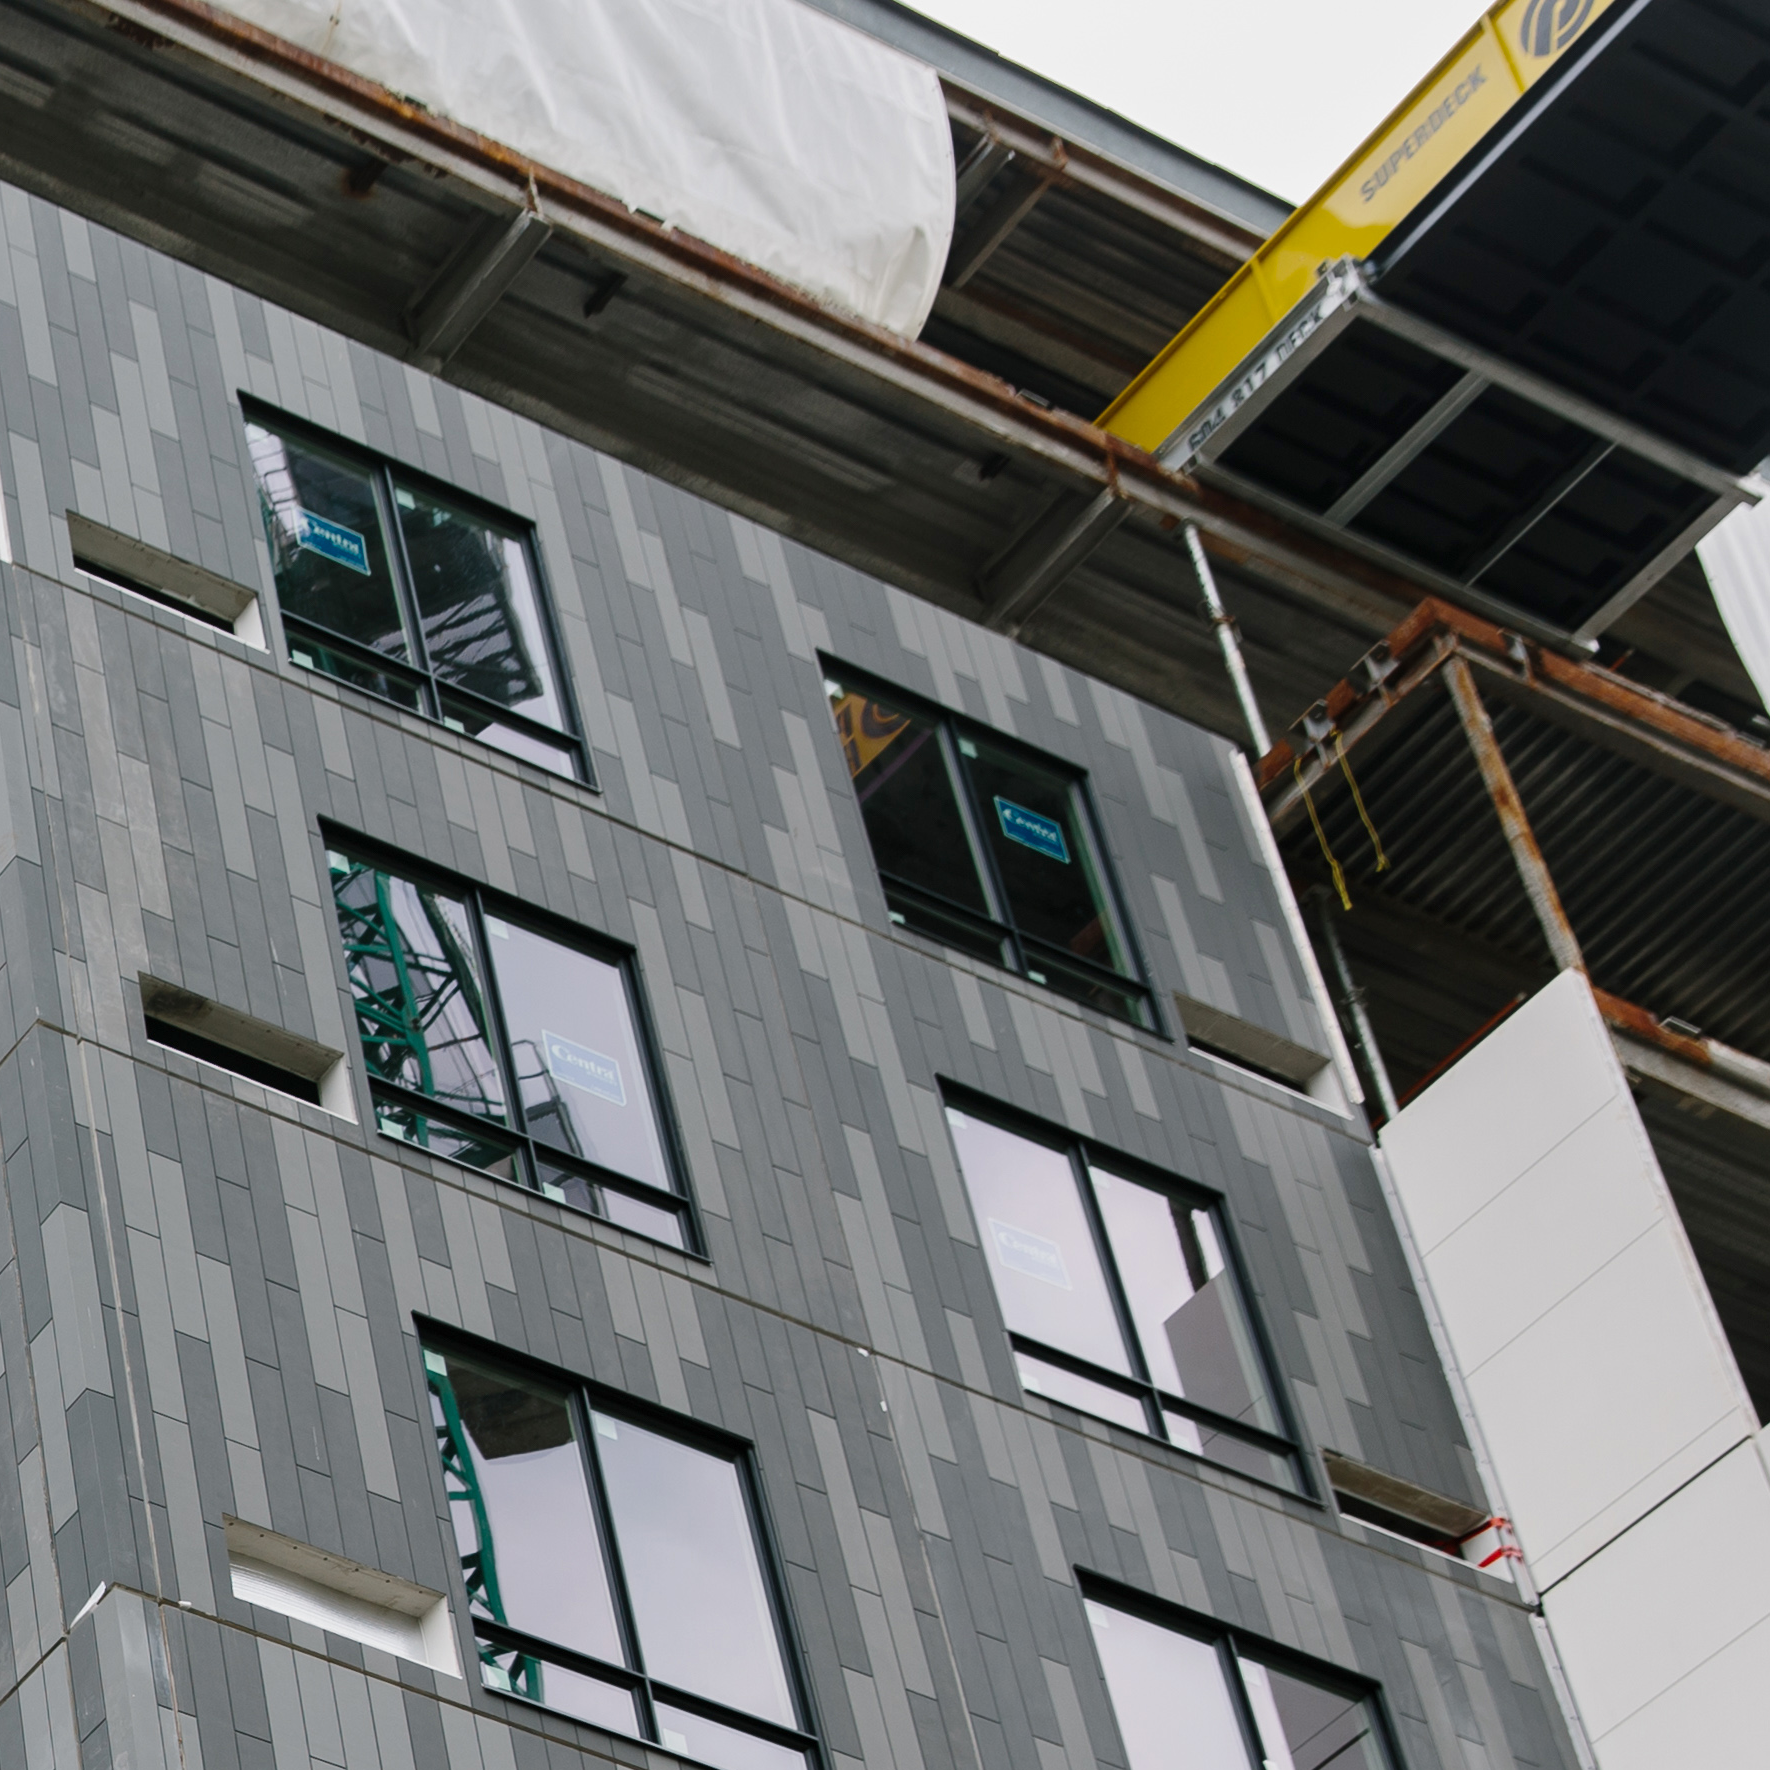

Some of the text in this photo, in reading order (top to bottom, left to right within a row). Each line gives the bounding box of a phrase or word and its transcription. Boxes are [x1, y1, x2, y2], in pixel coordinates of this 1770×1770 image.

[1361, 63, 1487, 204] SUPERDECK
[1276, 303, 1323, 362] DECK
[551, 1044, 615, 1080] Centra
